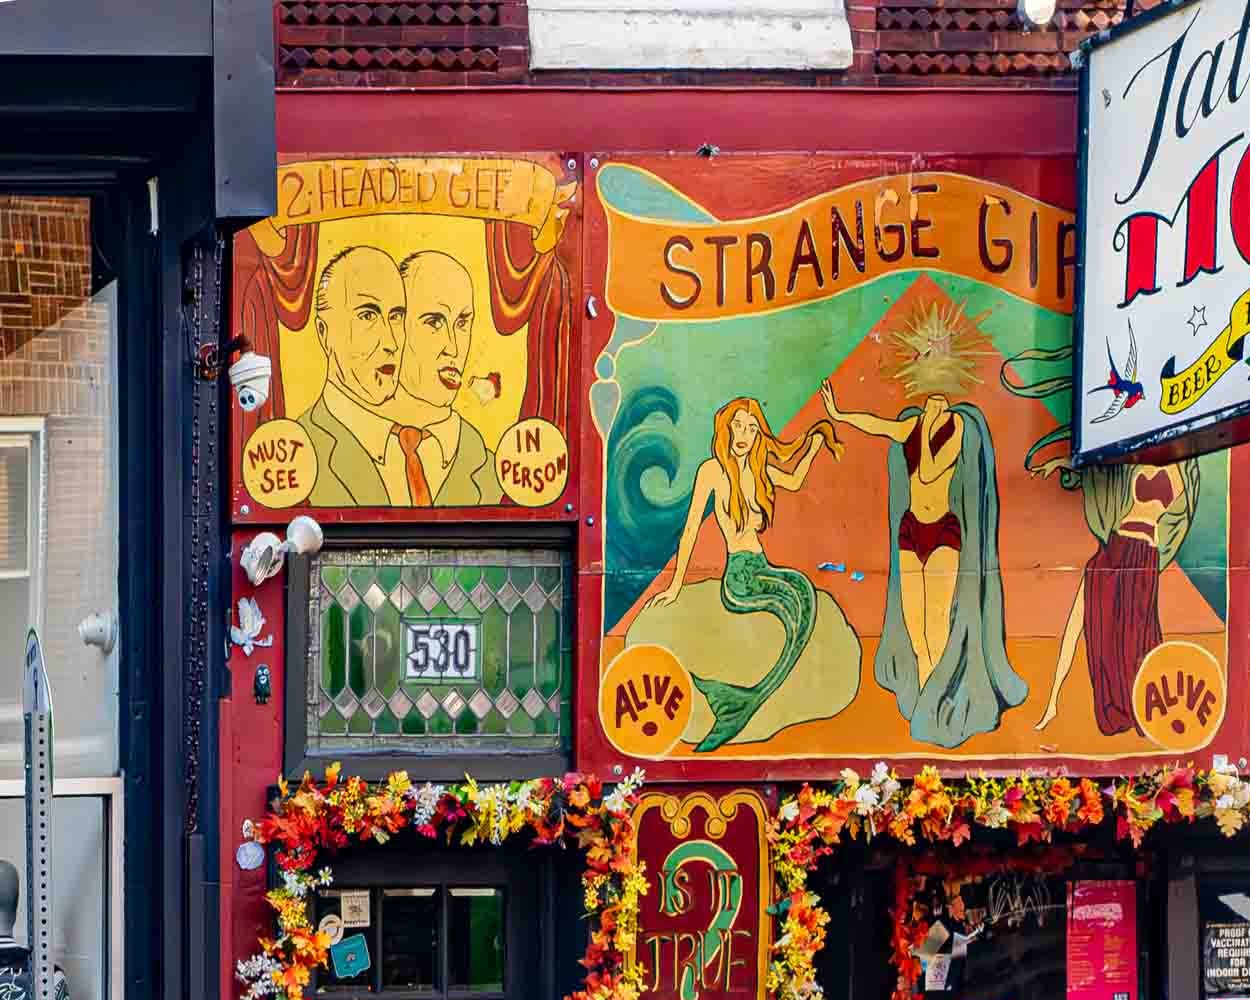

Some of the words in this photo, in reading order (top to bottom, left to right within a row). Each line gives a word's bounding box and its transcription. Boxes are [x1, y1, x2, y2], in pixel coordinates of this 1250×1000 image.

[660, 183, 941, 311] STRANGE
[978, 194, 1076, 301] GIR
[1166, 354, 1222, 407] BEER
[247, 437, 304, 471] MUST
[515, 427, 541, 453] IN
[259, 469, 300, 495] SEE
[500, 453, 567, 493] PERSON
[410, 625, 472, 673] 530
[614, 673, 685, 729] ALIVE
[1144, 670, 1217, 727] ALIVE
[656, 868, 693, 914] IS
[707, 868, 739, 911] IT
[1219, 927, 1245, 938] PROOF
[645, 929, 752, 993] TRUE
[1206, 967, 1240, 978] INDOOR
